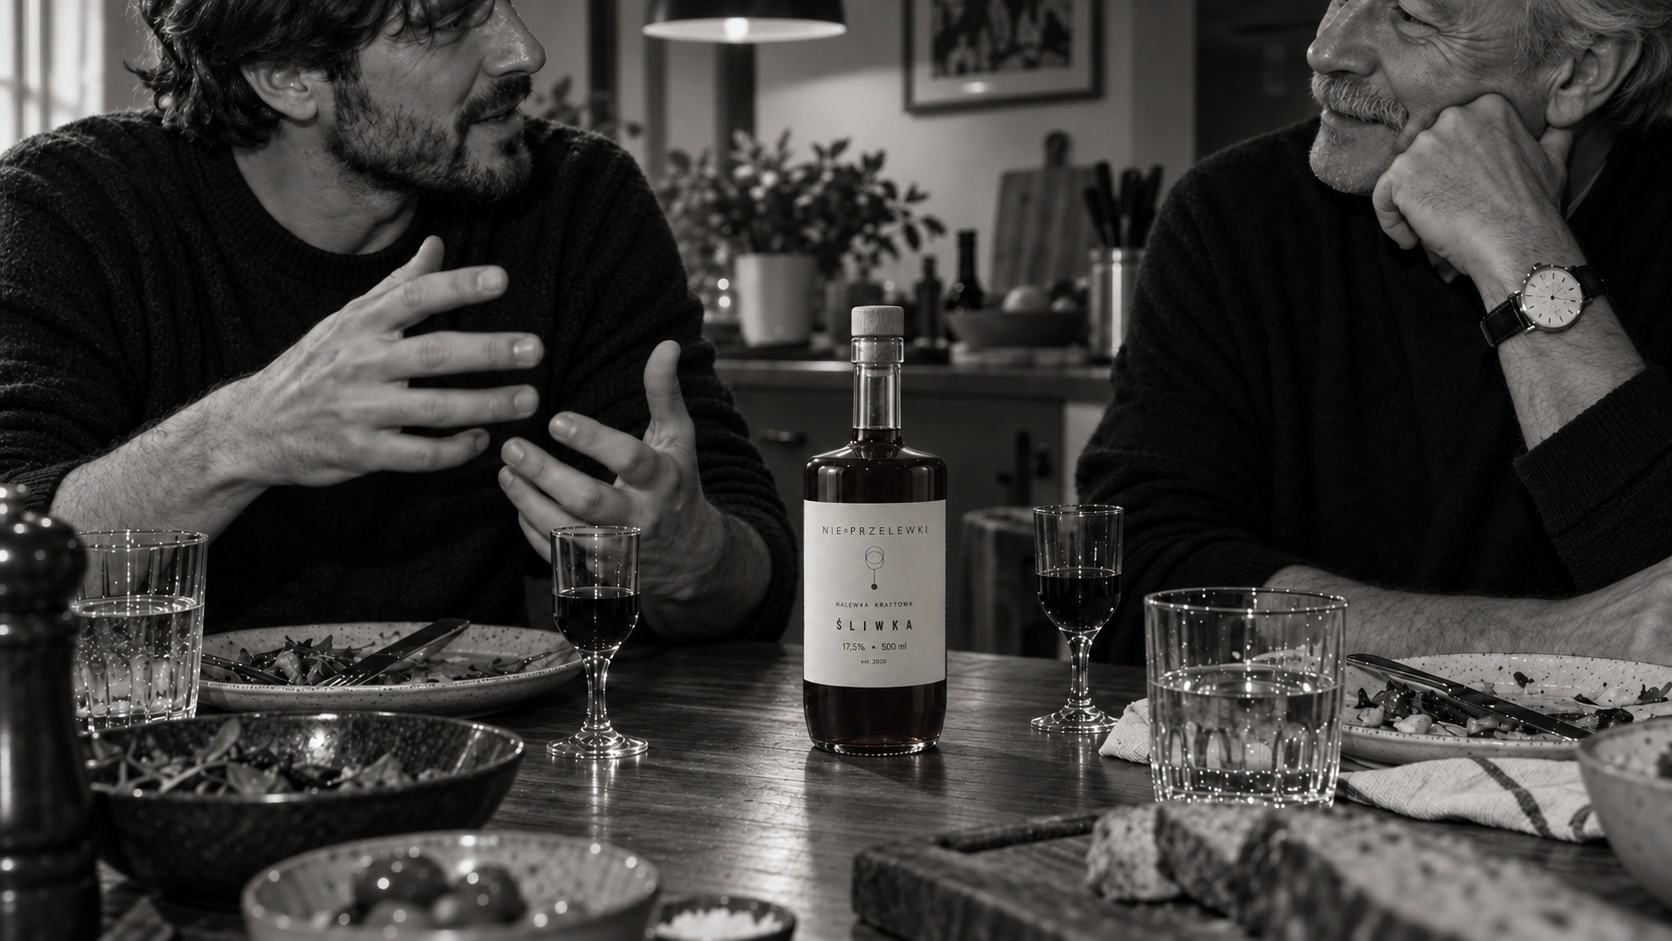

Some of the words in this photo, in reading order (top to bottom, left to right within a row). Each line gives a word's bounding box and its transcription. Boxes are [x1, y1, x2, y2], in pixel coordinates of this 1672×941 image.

[836, 617, 913, 631] ŚLIWKA
[842, 642, 866, 652] 17,5%
[881, 642, 897, 651] 500
[898, 642, 907, 650] ml
